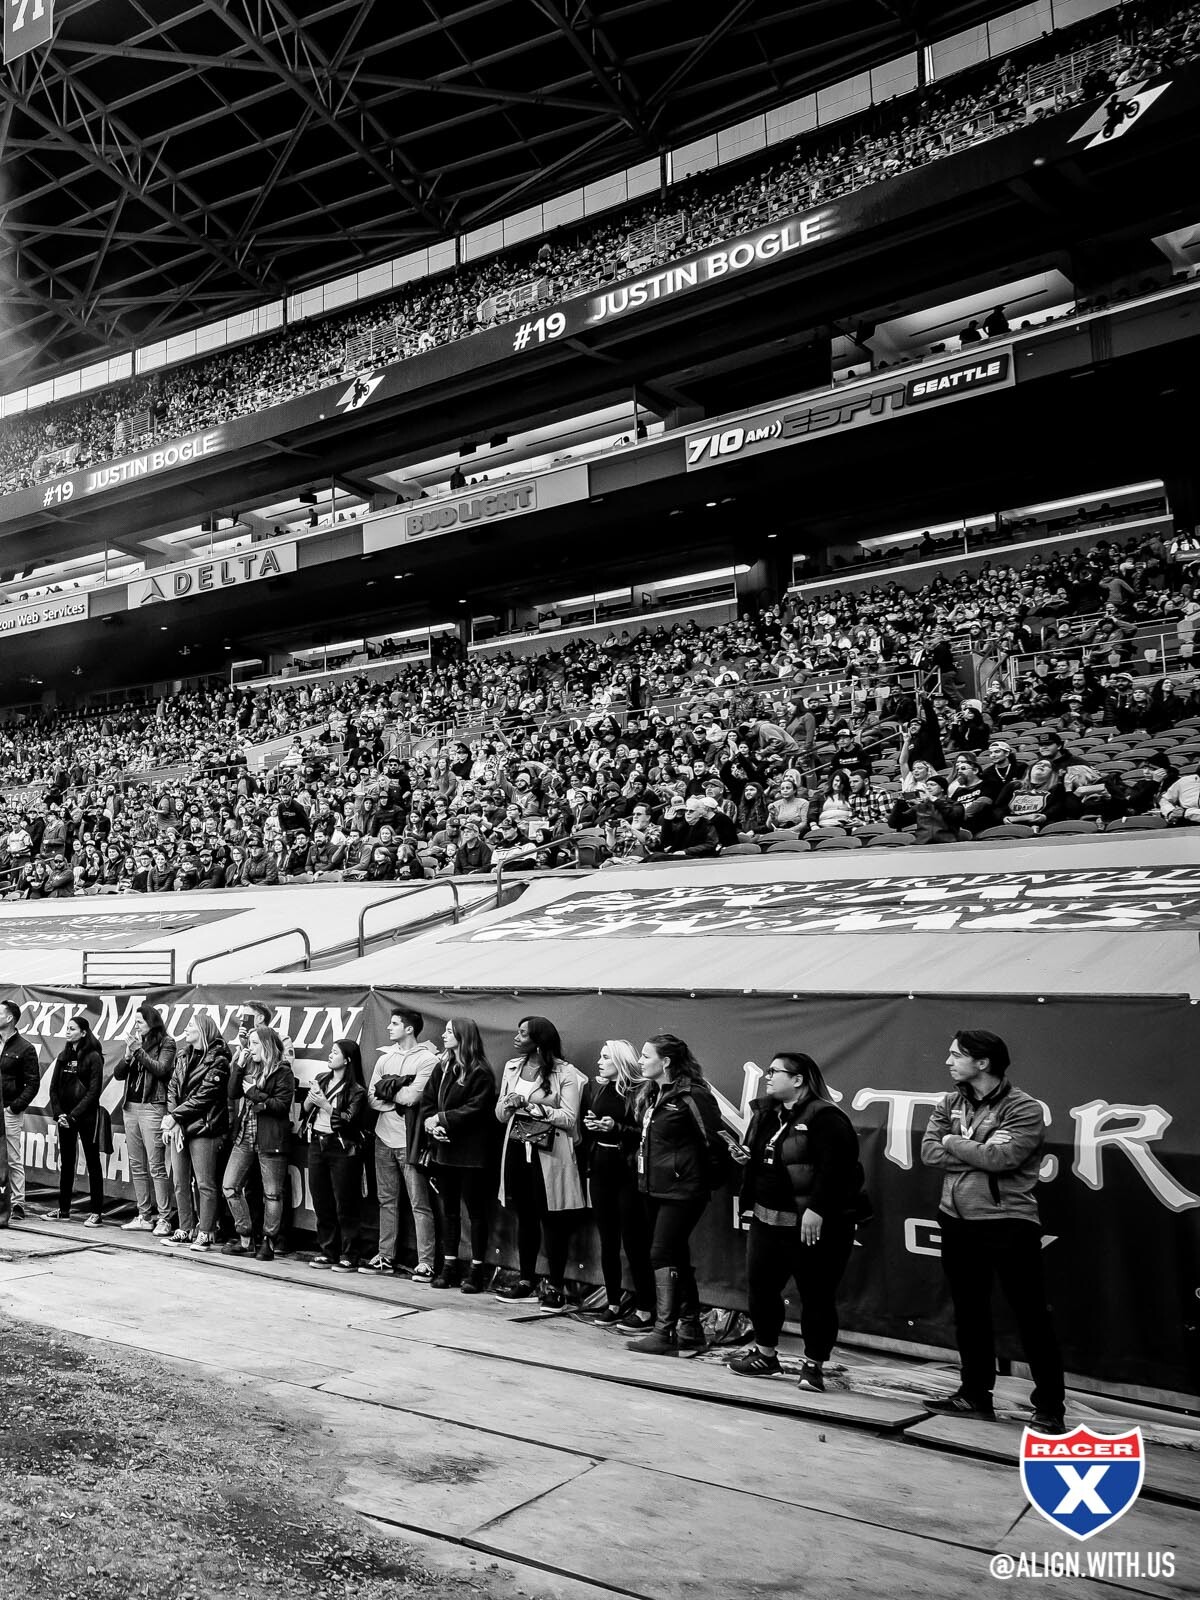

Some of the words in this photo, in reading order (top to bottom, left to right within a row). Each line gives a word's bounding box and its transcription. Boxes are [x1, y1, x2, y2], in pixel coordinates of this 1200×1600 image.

[512, 312, 567, 351] #19
[592, 260, 698, 323] JUSTIN
[704, 212, 824, 280] BOGLE
[687, 427, 745, 465] 710
[745, 423, 770, 444] AM
[782, 383, 906, 439] ESPN
[912, 360, 1001, 397] SEATTLE
[42, 481, 75, 508] #19
[87, 455, 149, 493] JUSTIN
[152, 431, 219, 471] BOGLE
[406, 506, 458, 536] BUD
[458, 485, 534, 523] LIGHT
[172, 549, 281, 595] DELTA
[17, 611, 40, 627] Web
[42, 604, 85, 621] Services
